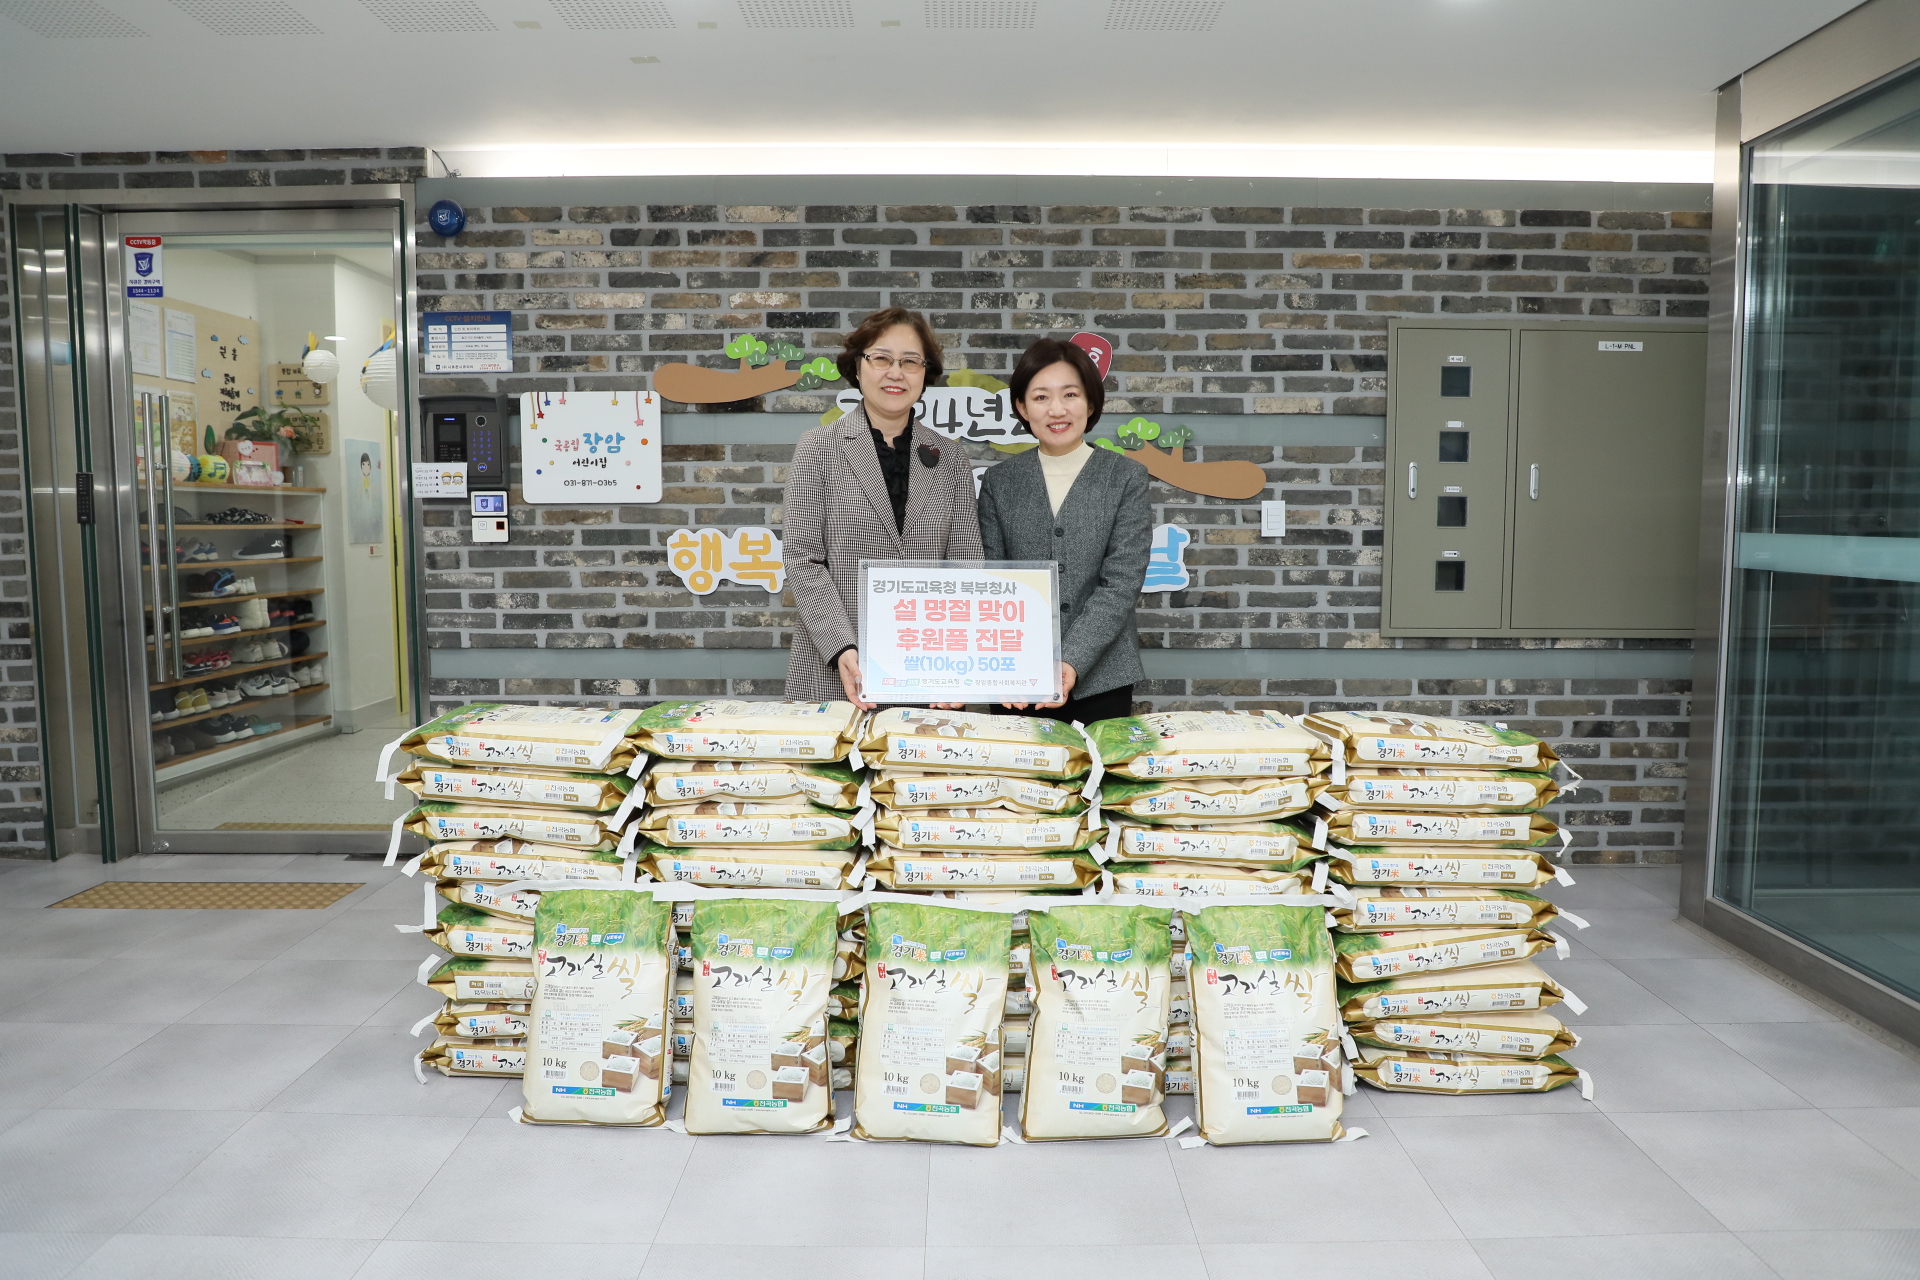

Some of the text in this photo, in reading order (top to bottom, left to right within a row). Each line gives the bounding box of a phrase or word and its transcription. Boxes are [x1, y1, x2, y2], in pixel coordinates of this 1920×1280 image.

[555, 432, 625, 453] 국공립 장암
[573, 457, 607, 468] 어린이집
[670, 532, 784, 592] 행복
[873, 580, 1017, 595] 경기도교육청 북부청사
[894, 599, 1025, 622] 설 명절 맞이
[897, 628, 1024, 651] 후원품 전달
[904, 656, 1016, 675] 쌀(10kg) 50포
[448, 745, 471, 756] 경기米
[667, 743, 694, 753] 경기米
[1378, 748, 1405, 758] 경기米
[898, 749, 927, 759] 경기米
[1147, 765, 1173, 775] 경기米
[435, 782, 462, 793] 경기米
[677, 787, 705, 796] 경기米
[909, 792, 938, 802] 경기米
[1366, 790, 1394, 800] 경기米
[1149, 801, 1175, 811] 경기米
[440, 828, 467, 837] 경기米
[679, 829, 707, 840] 경기米
[1369, 825, 1397, 835] 경기米
[912, 832, 940, 842] 경기米
[1136, 842, 1164, 851] 경기米
[454, 866, 481, 875] 경기米
[674, 871, 702, 880] 경기米
[1372, 869, 1399, 878] 경기米
[905, 872, 933, 882] 경기米
[474, 893, 501, 906] 경기米
[1369, 913, 1396, 923] 경기米
[555, 934, 588, 946] 경기米
[466, 942, 493, 952] 경기米
[718, 944, 753, 957] 경기米
[892, 945, 926, 961] 경기米
[1058, 949, 1093, 961] 경기米
[1218, 952, 1253, 965] 경기米
[1373, 963, 1401, 975] 경기米
[1381, 1006, 1409, 1015] 경기米
[470, 1026, 497, 1036] 경기米
[1395, 1034, 1420, 1044] 경기米
[457, 1059, 483, 1068] 경기米
[543, 1057, 567, 1068] 10 kg
[712, 1070, 736, 1081] 10 kg
[884, 1072, 909, 1084] 10 kg
[1059, 1071, 1085, 1084] 10 kg
[1394, 1073, 1421, 1082] 경기米
[1233, 1078, 1259, 1089] 10 kg
